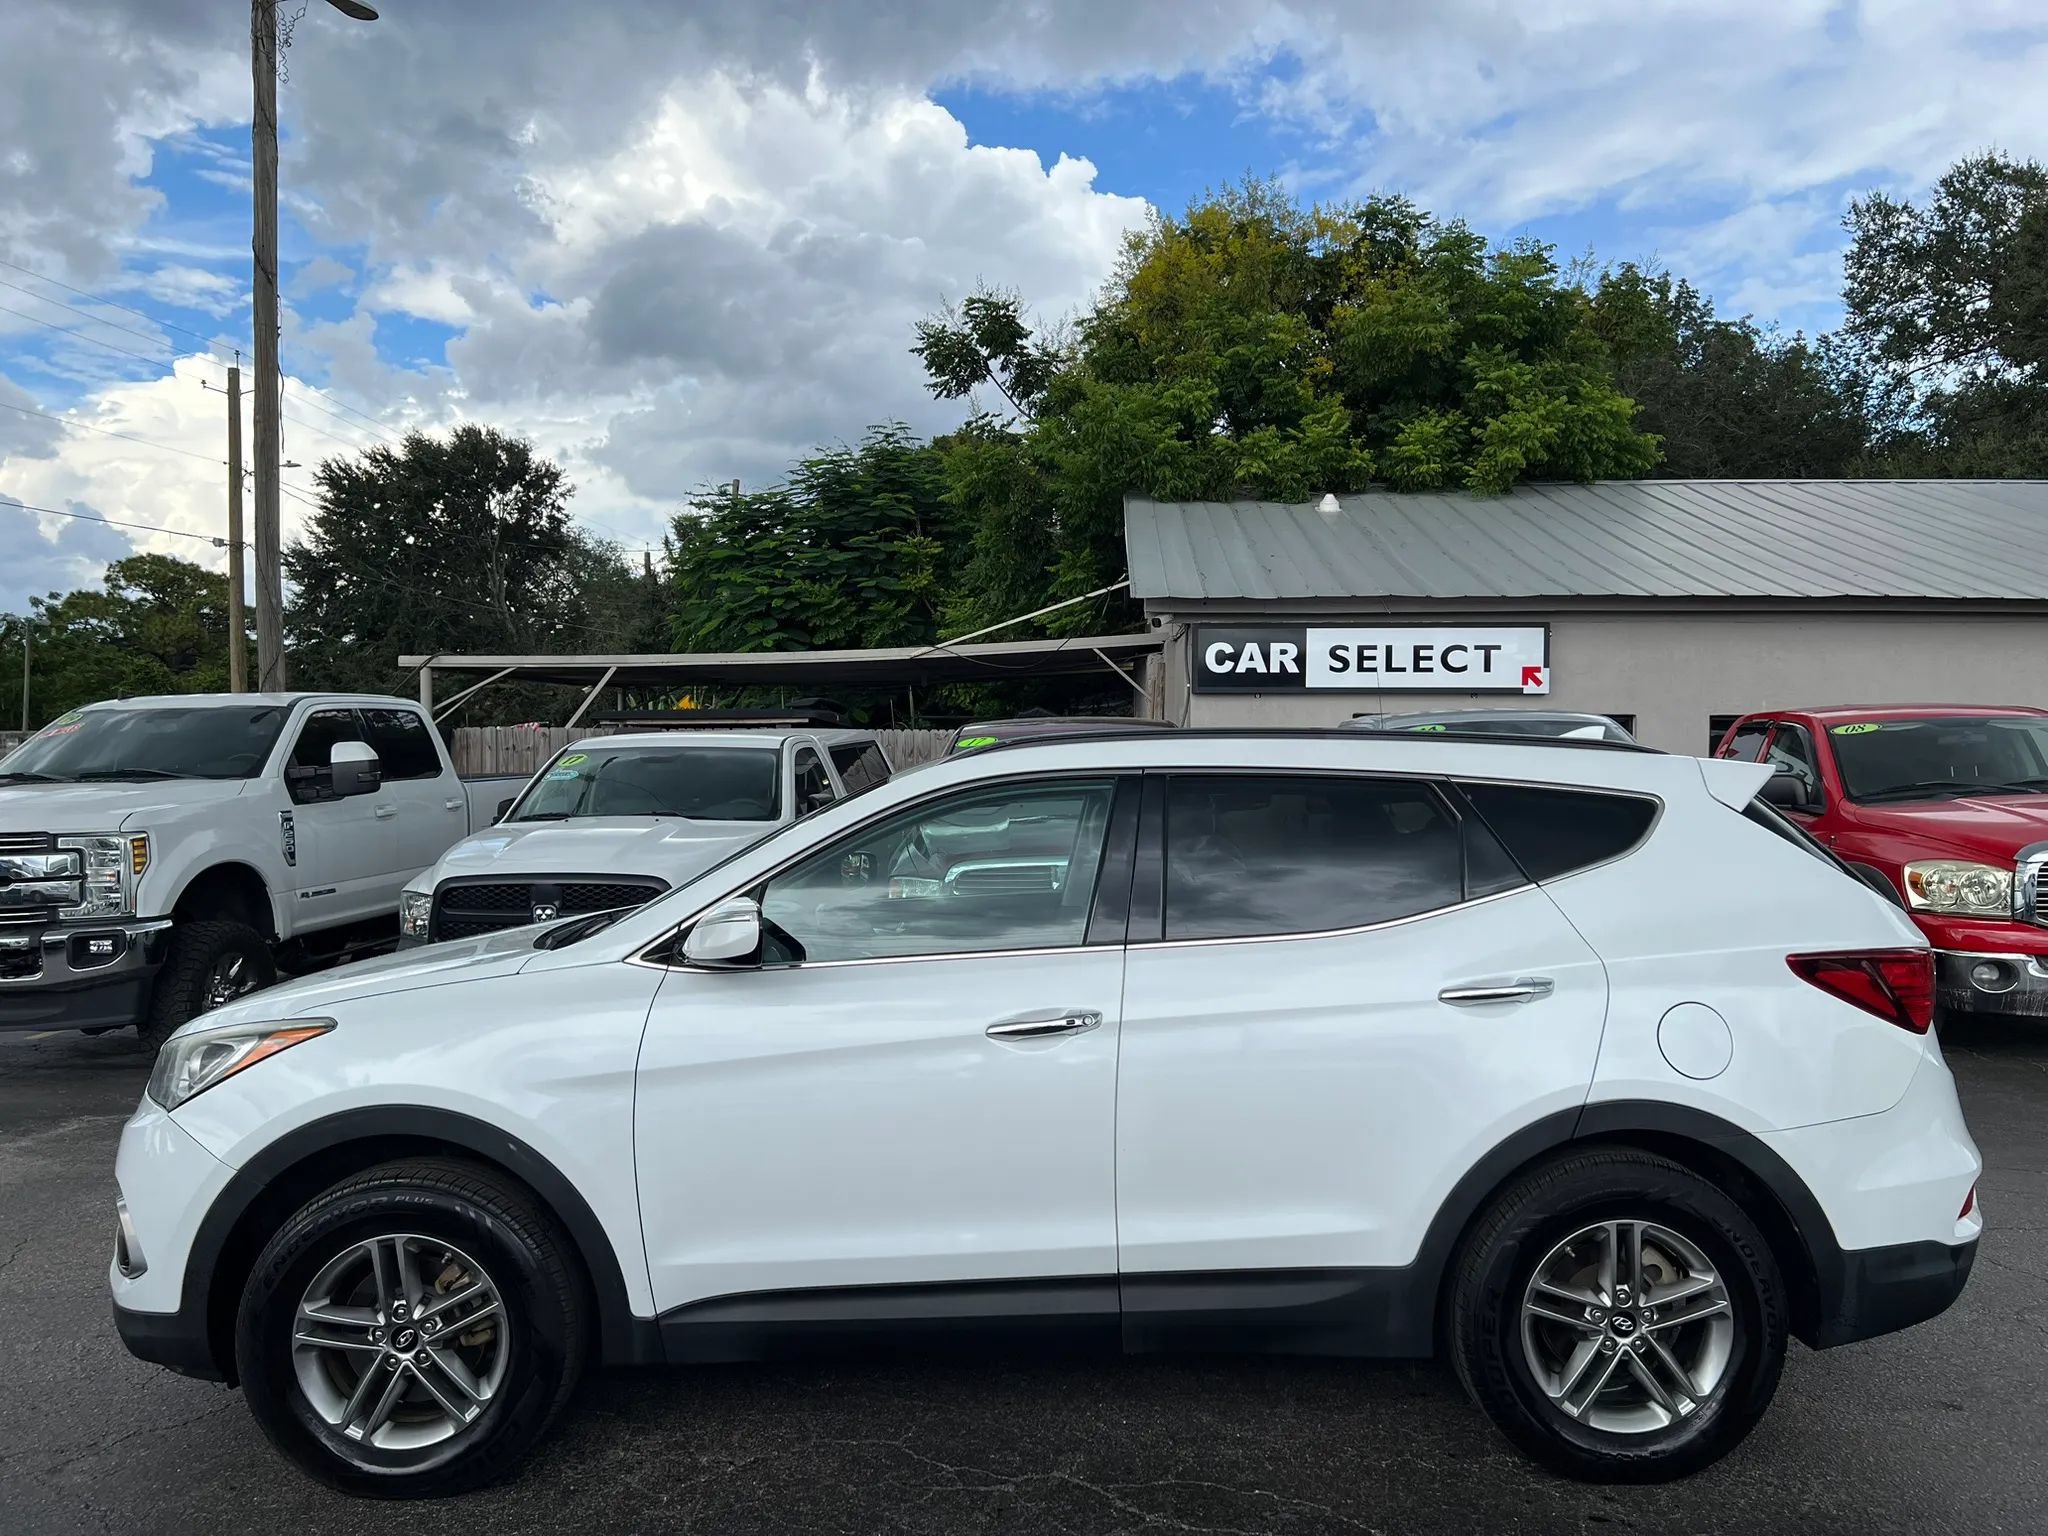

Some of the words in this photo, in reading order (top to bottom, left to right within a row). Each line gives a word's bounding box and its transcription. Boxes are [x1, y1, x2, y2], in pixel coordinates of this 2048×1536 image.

[1205, 642, 1300, 673] CAR
[1328, 644, 1502, 673] SELECT
[1844, 724, 1866, 733] 08
[264, 1194, 390, 1291] ENDEAVOR
[394, 1195, 434, 1206] PLUS
